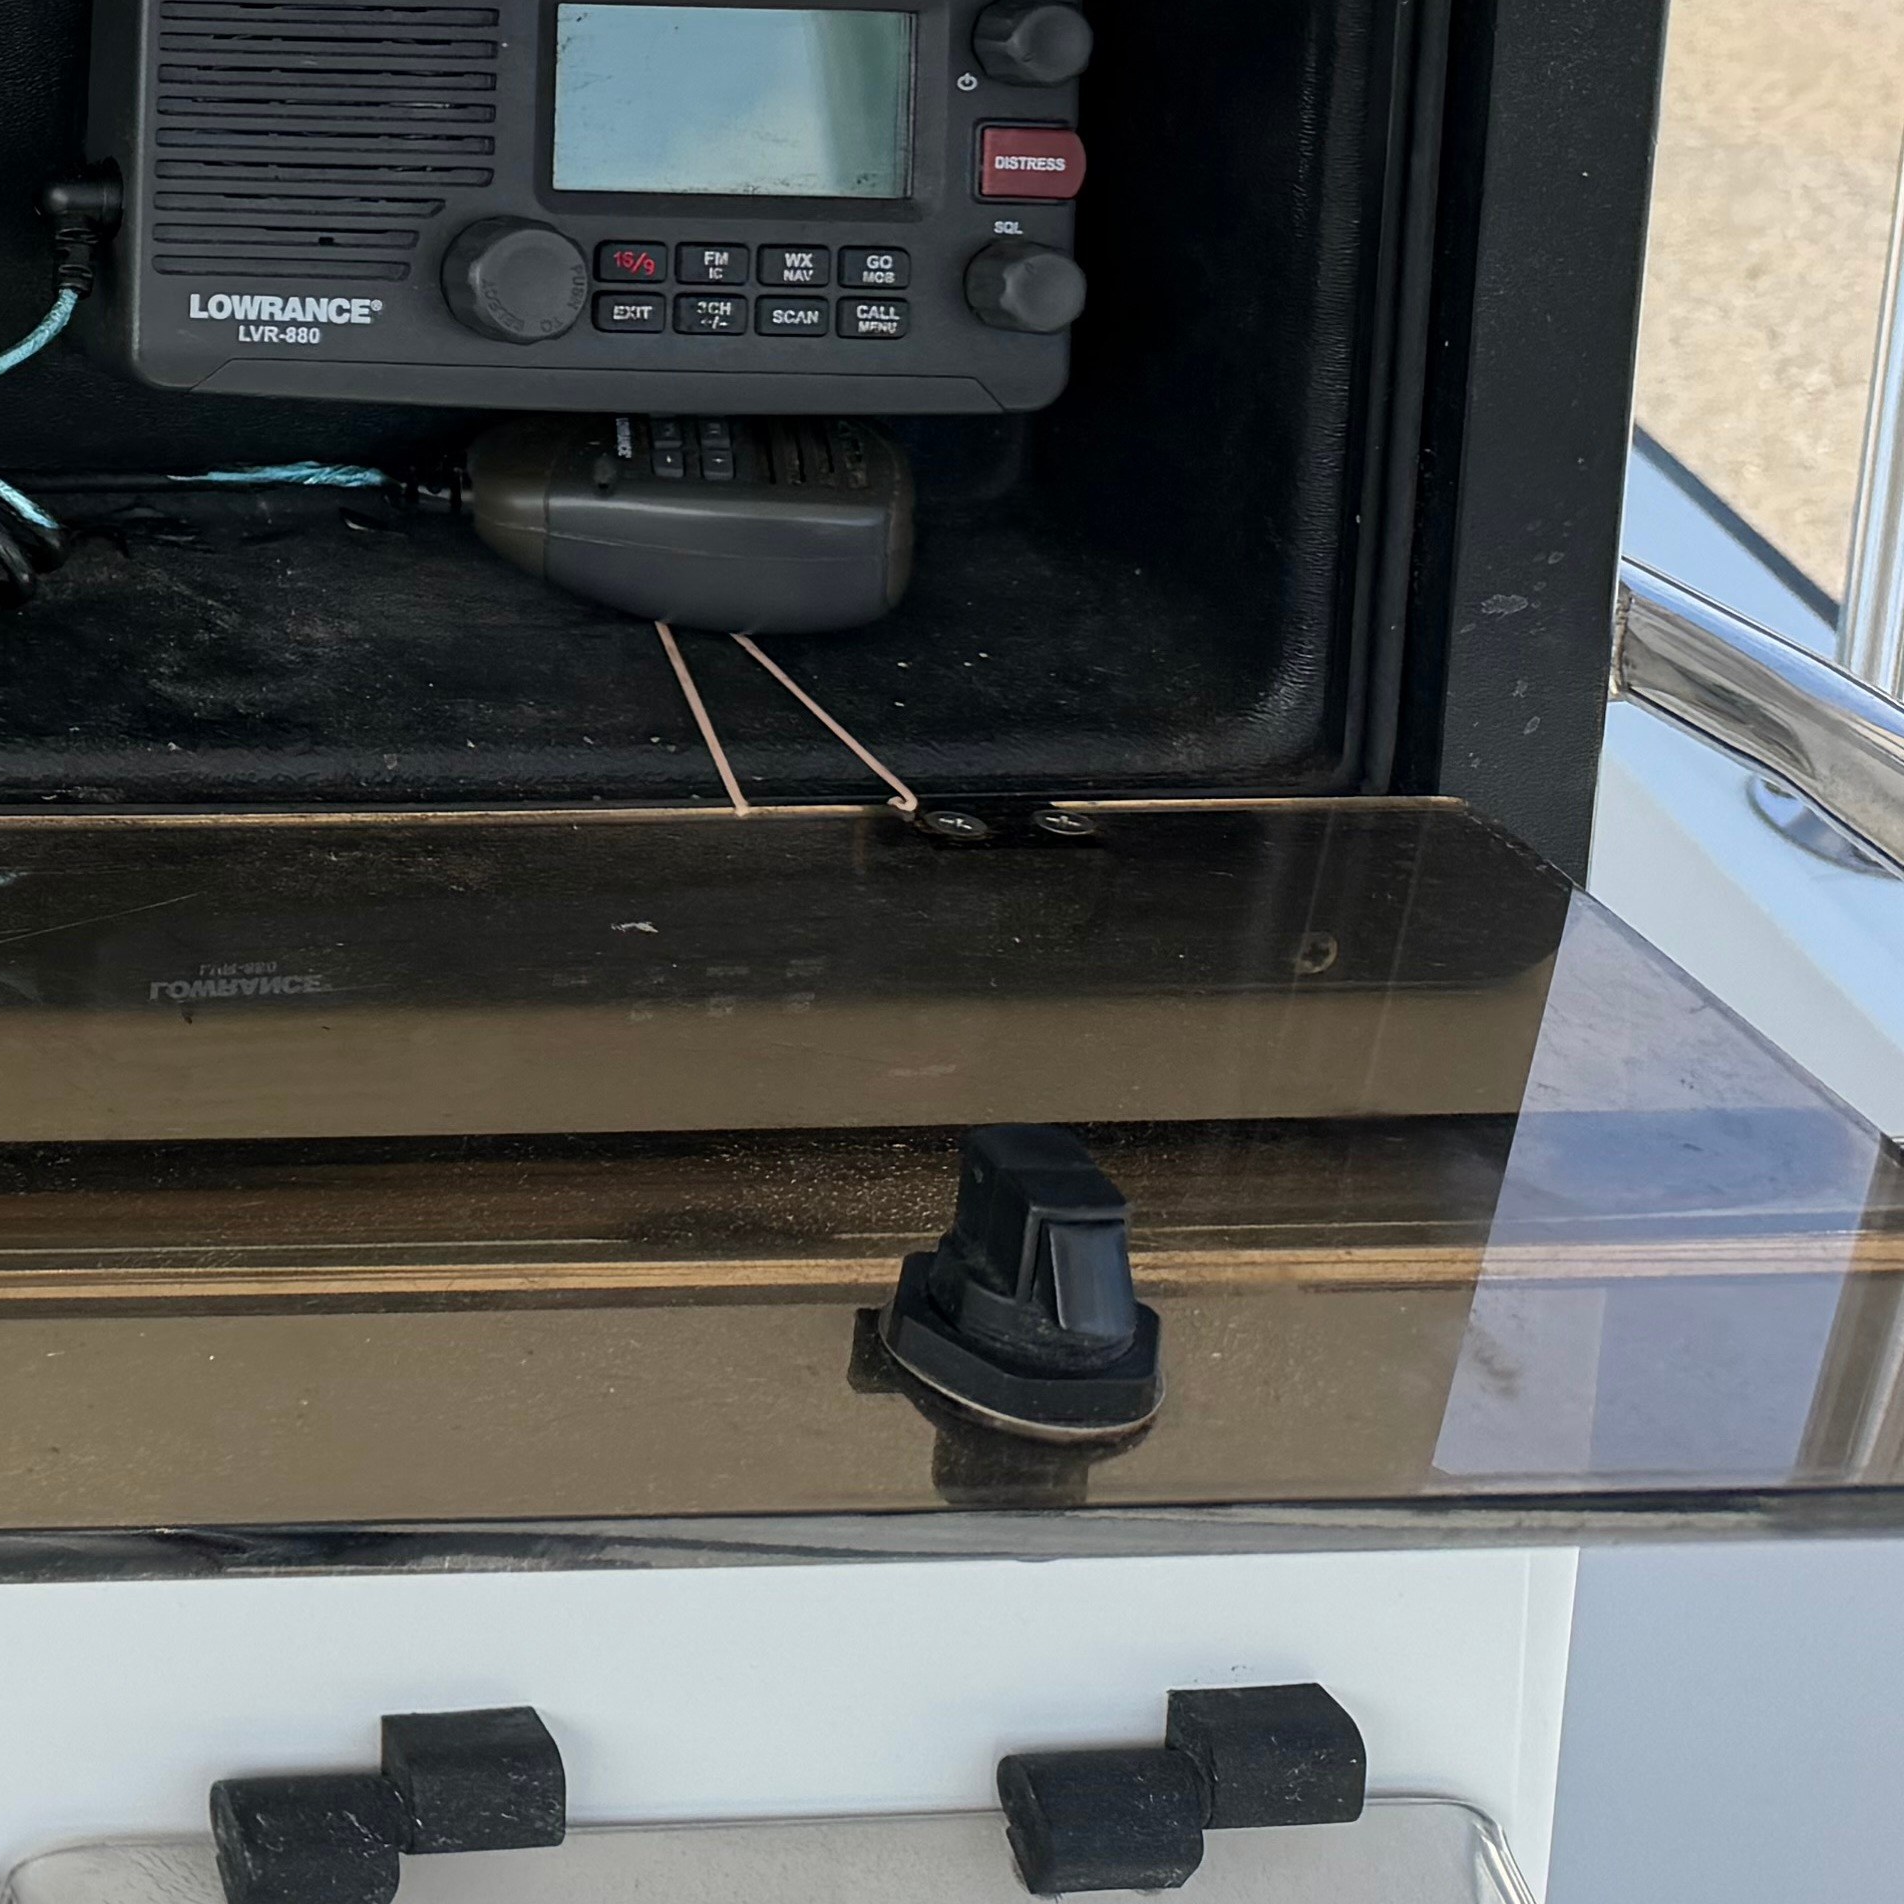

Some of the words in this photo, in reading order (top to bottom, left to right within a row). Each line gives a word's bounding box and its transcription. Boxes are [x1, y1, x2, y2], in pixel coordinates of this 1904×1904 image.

[994, 155, 1067, 172] DISTRESS
[994, 220, 1024, 235] SQL
[613, 249, 657, 278] 16/9
[703, 250, 730, 266] FM
[784, 252, 814, 268] WX
[866, 254, 893, 269] GO
[708, 267, 724, 280] IC
[783, 269, 814, 282] NAV
[612, 305, 654, 321] EXIT
[696, 300, 732, 316] 3CH
[856, 304, 901, 320] CALL
[771, 309, 820, 325] SCAN
[237, 324, 321, 345] LVR-880
[858, 320, 898, 334] MENU
